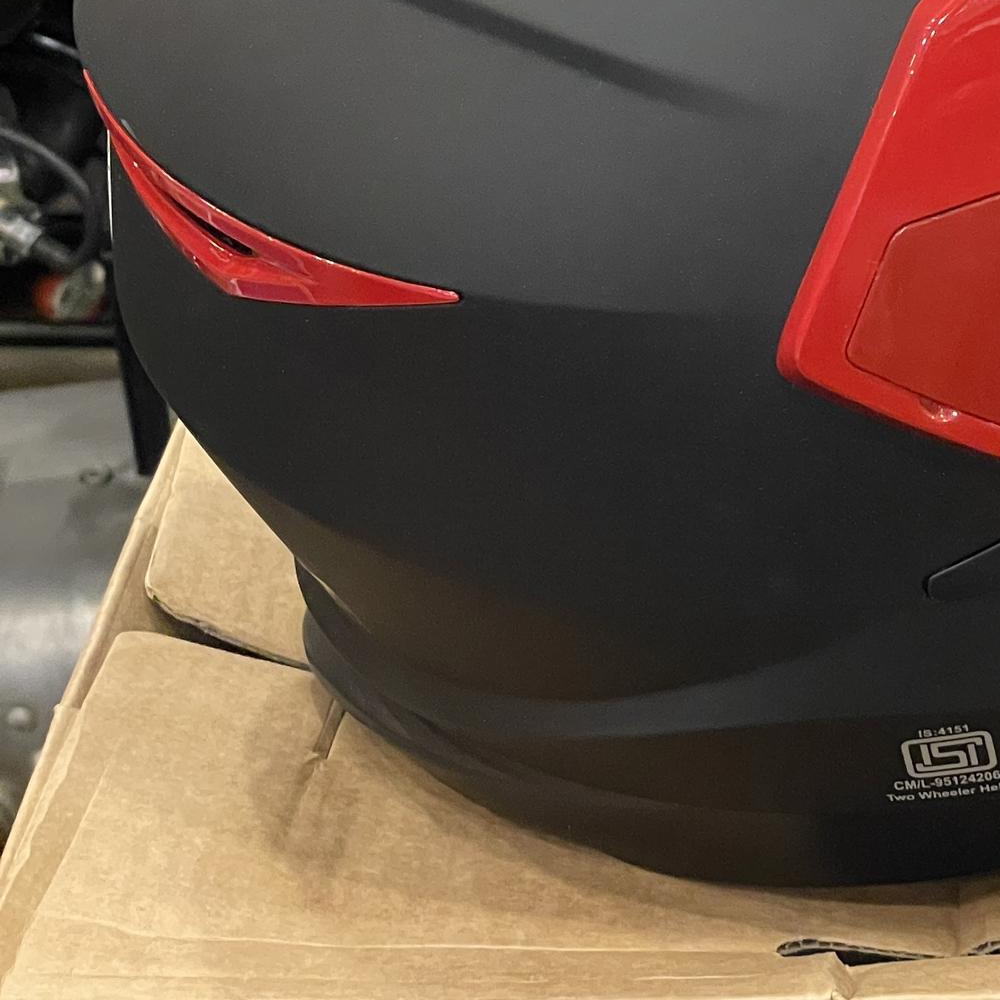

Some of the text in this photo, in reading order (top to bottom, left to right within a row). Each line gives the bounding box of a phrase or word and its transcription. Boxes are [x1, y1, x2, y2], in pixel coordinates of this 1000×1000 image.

[918, 723, 970, 739] IS:4151
[886, 792, 916, 802] Two
[918, 786, 977, 800] Wheeler
